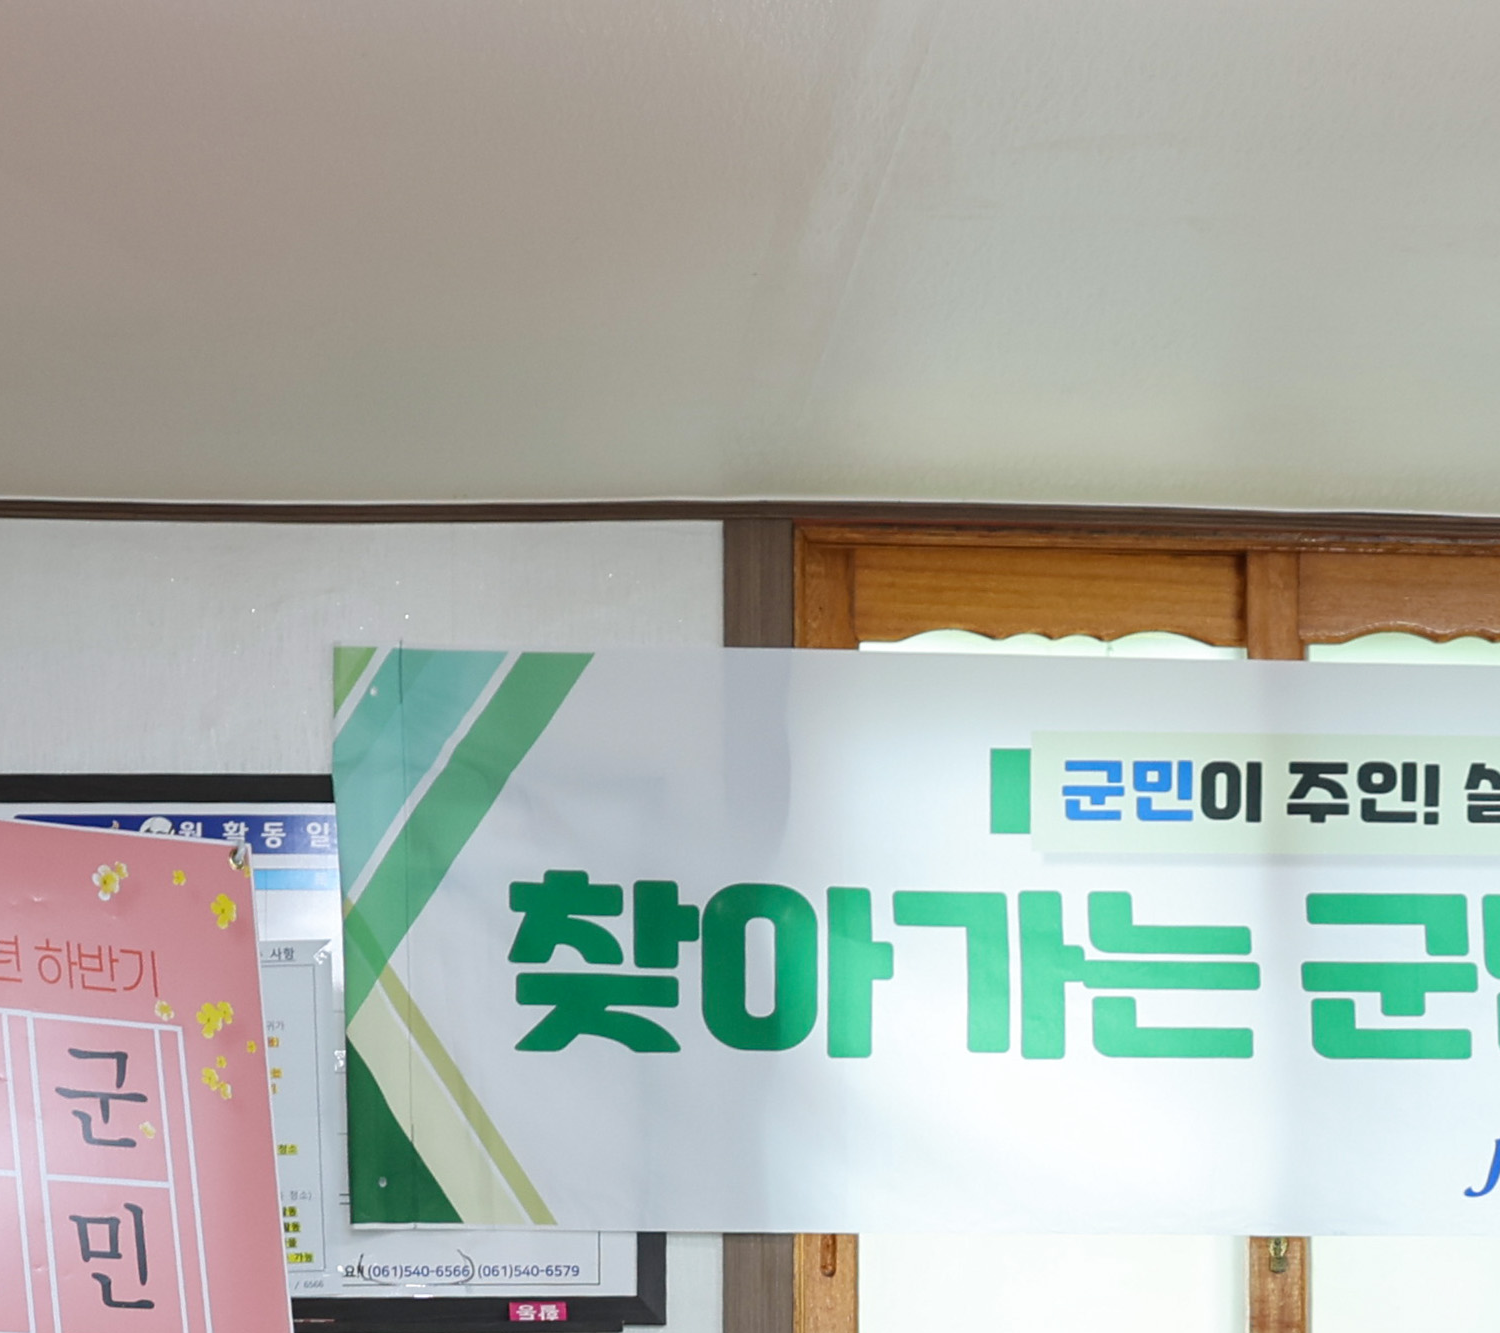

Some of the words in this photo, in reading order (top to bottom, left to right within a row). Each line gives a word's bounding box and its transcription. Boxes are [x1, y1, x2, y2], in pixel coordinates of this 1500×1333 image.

[1061, 759, 1263, 823] 군민이
[1286, 760, 1440, 826] 주인!
[33, 937, 160, 999] 하반기
[509, 872, 1262, 1061] 찾아가는
[367, 1264, 471, 1279] (061)540-6566
[477, 1264, 580, 1280] (061)540-6579
